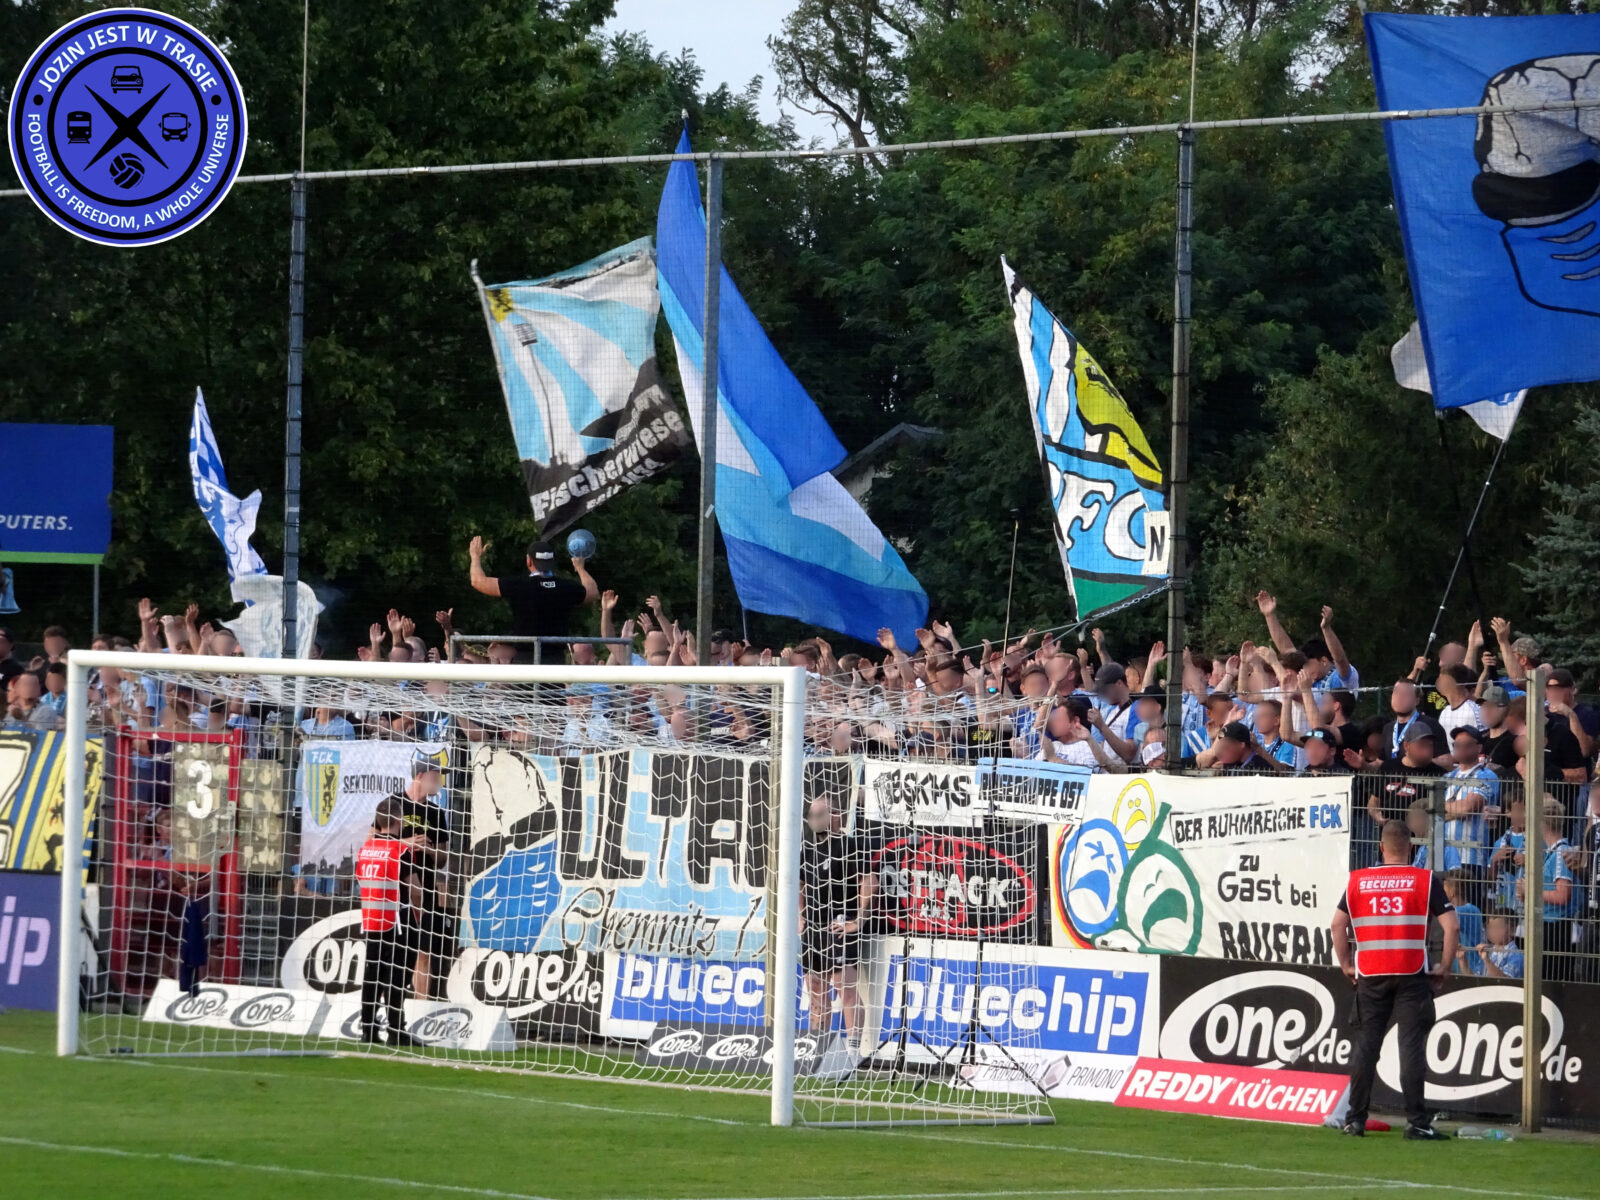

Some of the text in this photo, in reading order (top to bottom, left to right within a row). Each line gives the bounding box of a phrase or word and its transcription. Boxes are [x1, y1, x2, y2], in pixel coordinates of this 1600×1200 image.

[187, 760, 214, 819] 3
[1060, 780, 1085, 810] OST
[1175, 803, 1343, 843] DER RUHMREICHE FCK
[361, 863, 380, 878] 107
[1218, 871, 1317, 909] Gast bei
[1359, 880, 1414, 889] SECURITY
[1369, 896, 1403, 914] 133
[890, 963, 1137, 1052] bluechip
[1205, 1003, 1351, 1066] one.de
[1124, 1069, 1338, 1114] REDDY KÜCHEN
